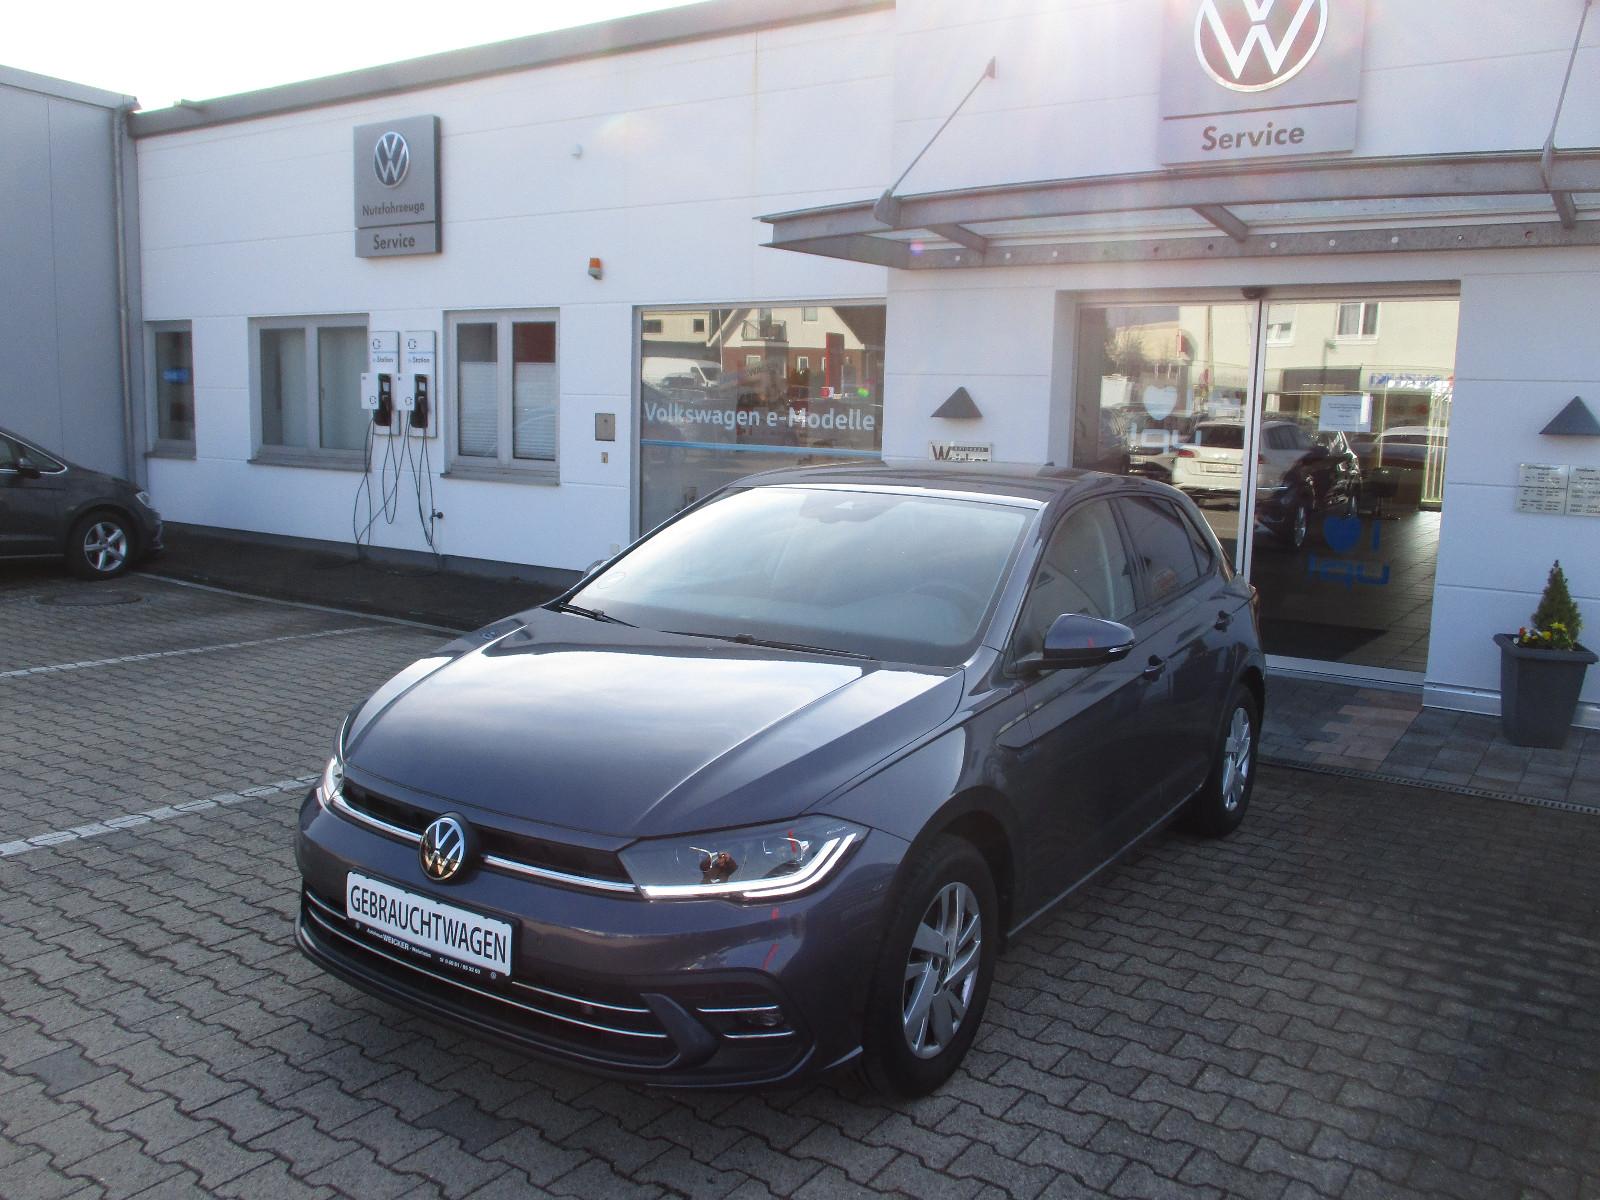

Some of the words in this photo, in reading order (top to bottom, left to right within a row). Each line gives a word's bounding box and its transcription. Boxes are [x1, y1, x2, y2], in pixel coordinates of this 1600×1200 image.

[1201, 121, 1305, 151] Service
[361, 201, 425, 217] Nutzfahrzeuge
[372, 233, 416, 250] Service
[643, 402, 760, 431] Volkswagen
[766, 405, 876, 431] e-Modelle
[350, 885, 507, 964] GEBRAUCHTWAGEN
